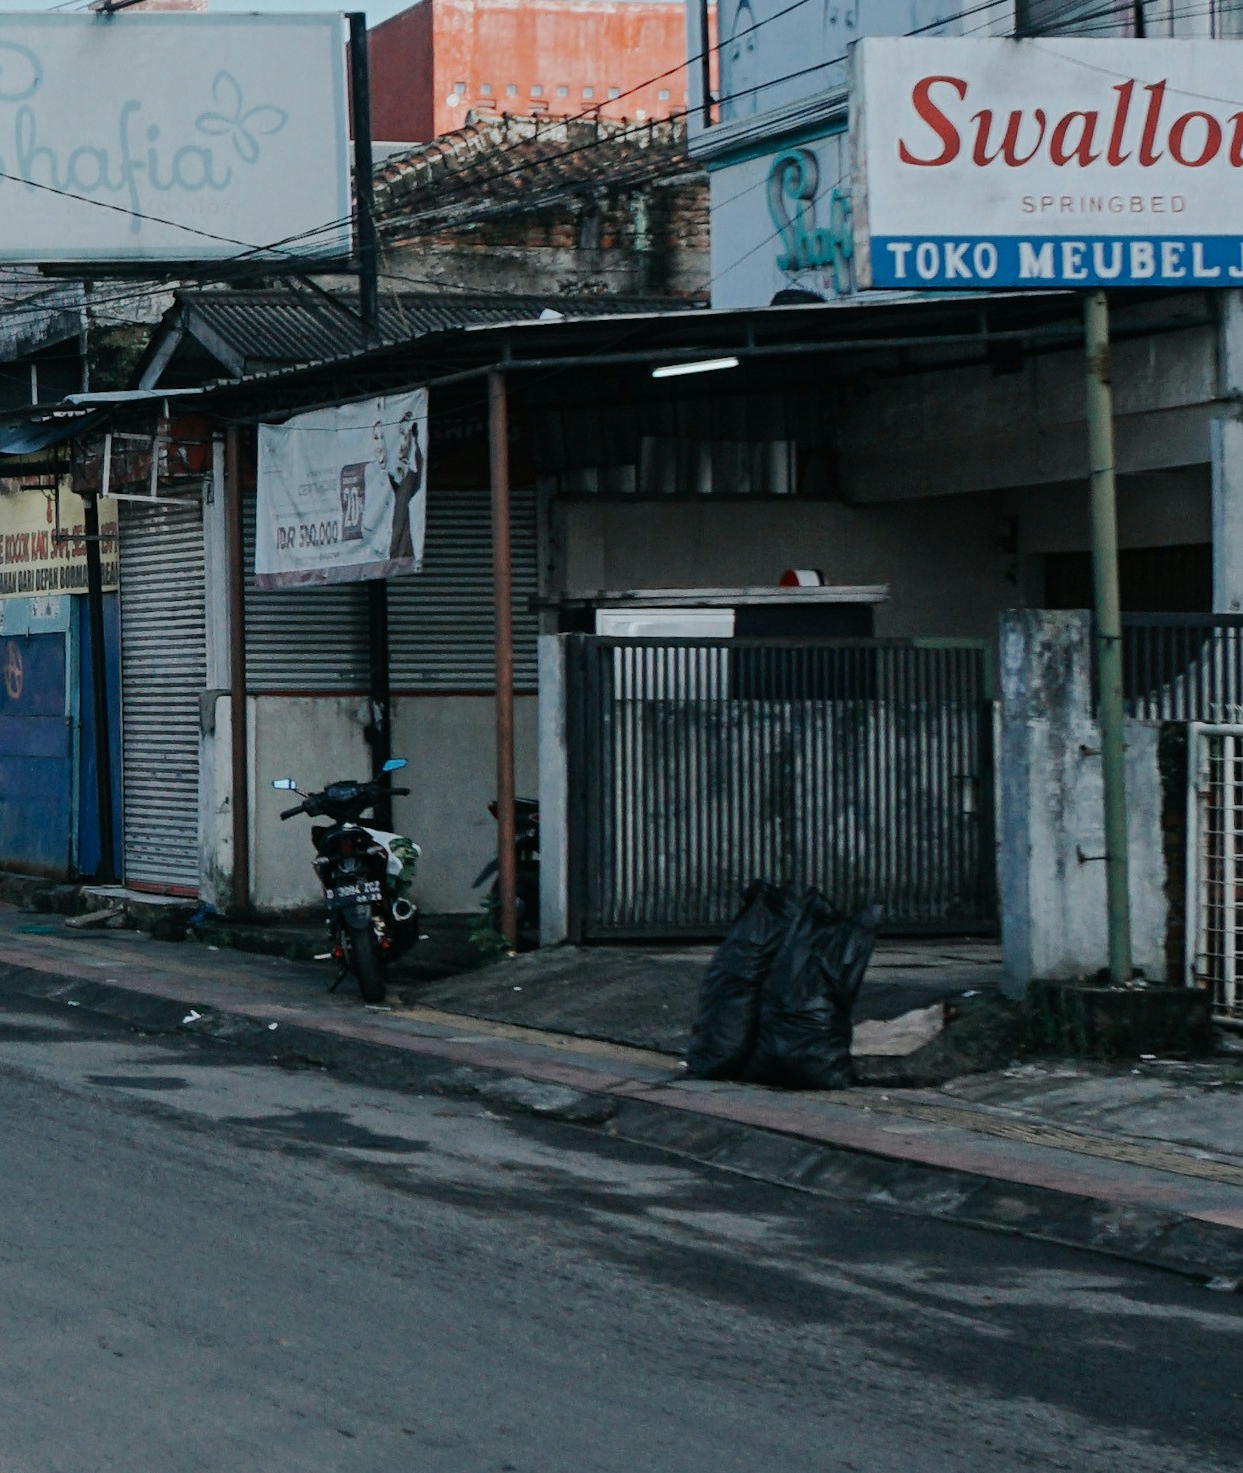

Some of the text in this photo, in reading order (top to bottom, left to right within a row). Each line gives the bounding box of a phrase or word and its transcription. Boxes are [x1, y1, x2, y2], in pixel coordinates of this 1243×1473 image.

[898, 74, 1243, 168] Swallo
[1021, 195, 1187, 214] SPRINGBED
[886, 241, 999, 280] TOKO
[1018, 241, 1221, 280] MEUBEL
